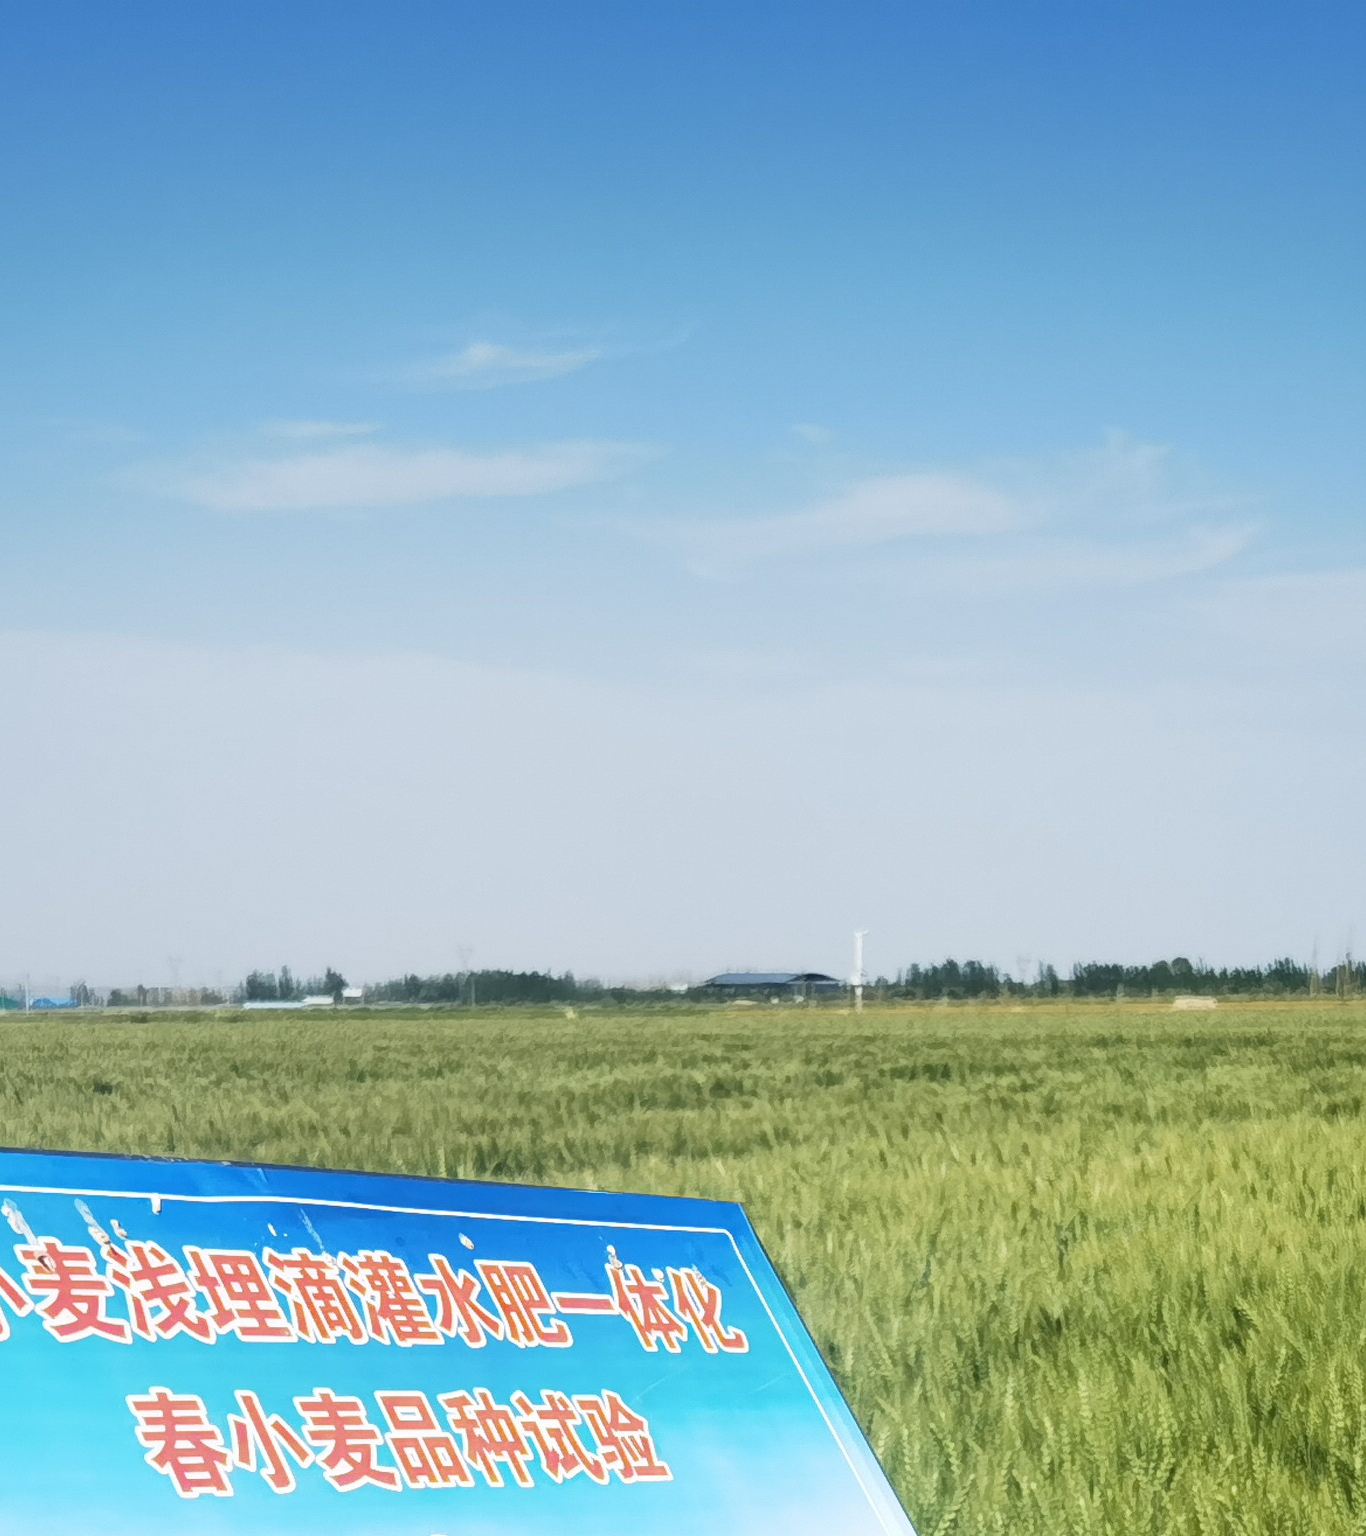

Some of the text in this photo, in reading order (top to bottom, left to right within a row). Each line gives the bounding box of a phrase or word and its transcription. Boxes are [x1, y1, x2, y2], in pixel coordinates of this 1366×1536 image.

[135, 1388, 671, 1495] 春小麦品种试验
